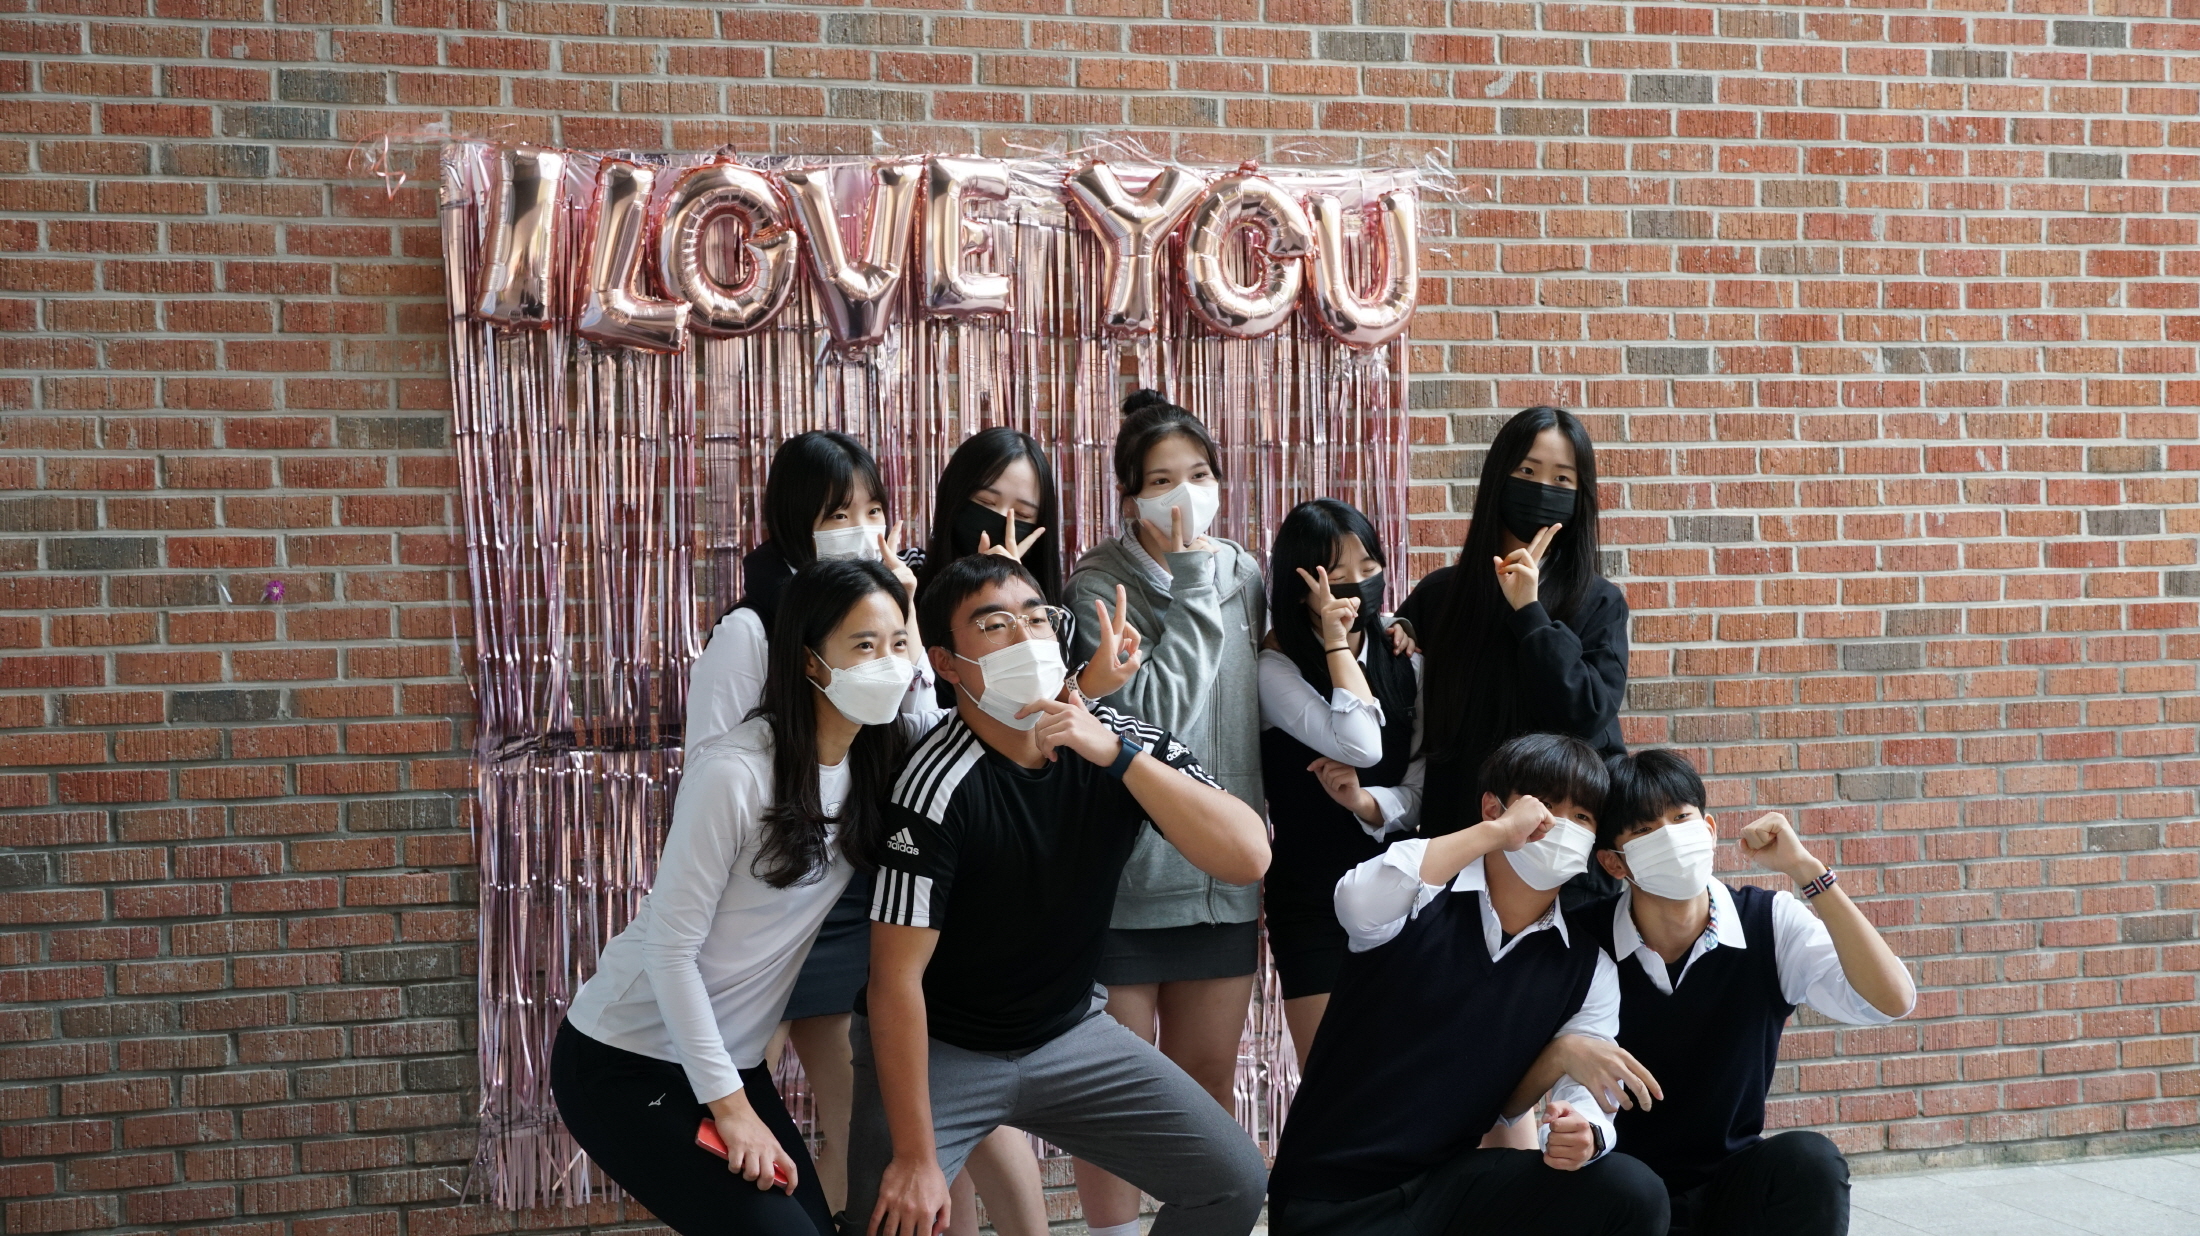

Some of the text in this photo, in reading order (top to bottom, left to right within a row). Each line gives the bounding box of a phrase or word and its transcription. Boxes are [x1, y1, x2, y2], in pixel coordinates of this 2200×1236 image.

[474, 143, 1419, 353] I LOVE YOU
[887, 840, 920, 856] adidas
